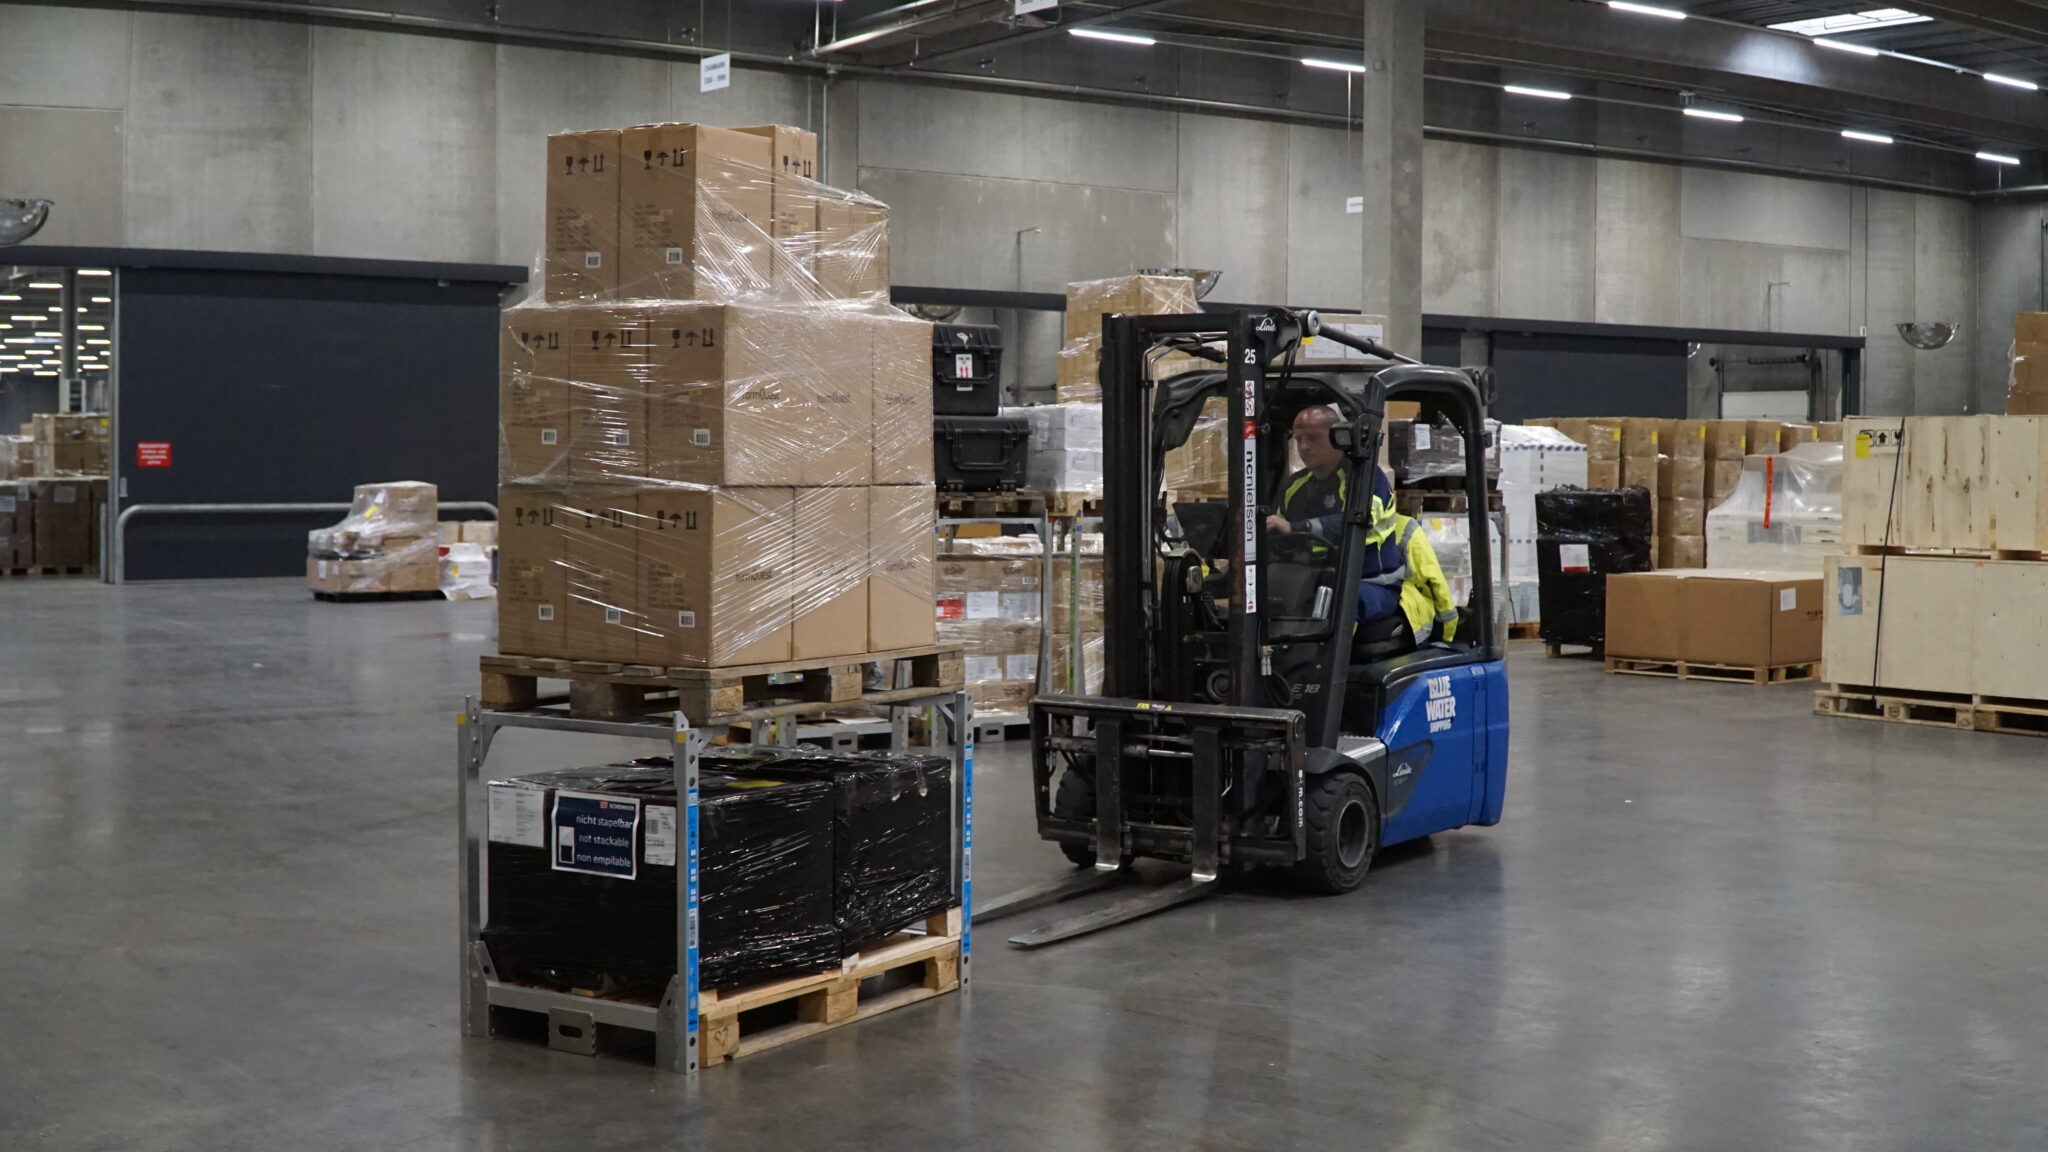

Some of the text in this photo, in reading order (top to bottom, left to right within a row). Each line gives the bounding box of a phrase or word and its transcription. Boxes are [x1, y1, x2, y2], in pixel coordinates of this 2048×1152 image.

[1256, 317, 1277, 331] Lind
[1244, 348, 1256, 365] 25
[1245, 450, 1255, 542] ncnielsen
[1304, 684, 1321, 694] 18
[1427, 675, 1452, 699] BLUE
[1426, 696, 1456, 722] WATER
[576, 814, 634, 829] nicht stapelbar
[579, 834, 630, 848] not stackable
[576, 853, 632, 868] non empilable
